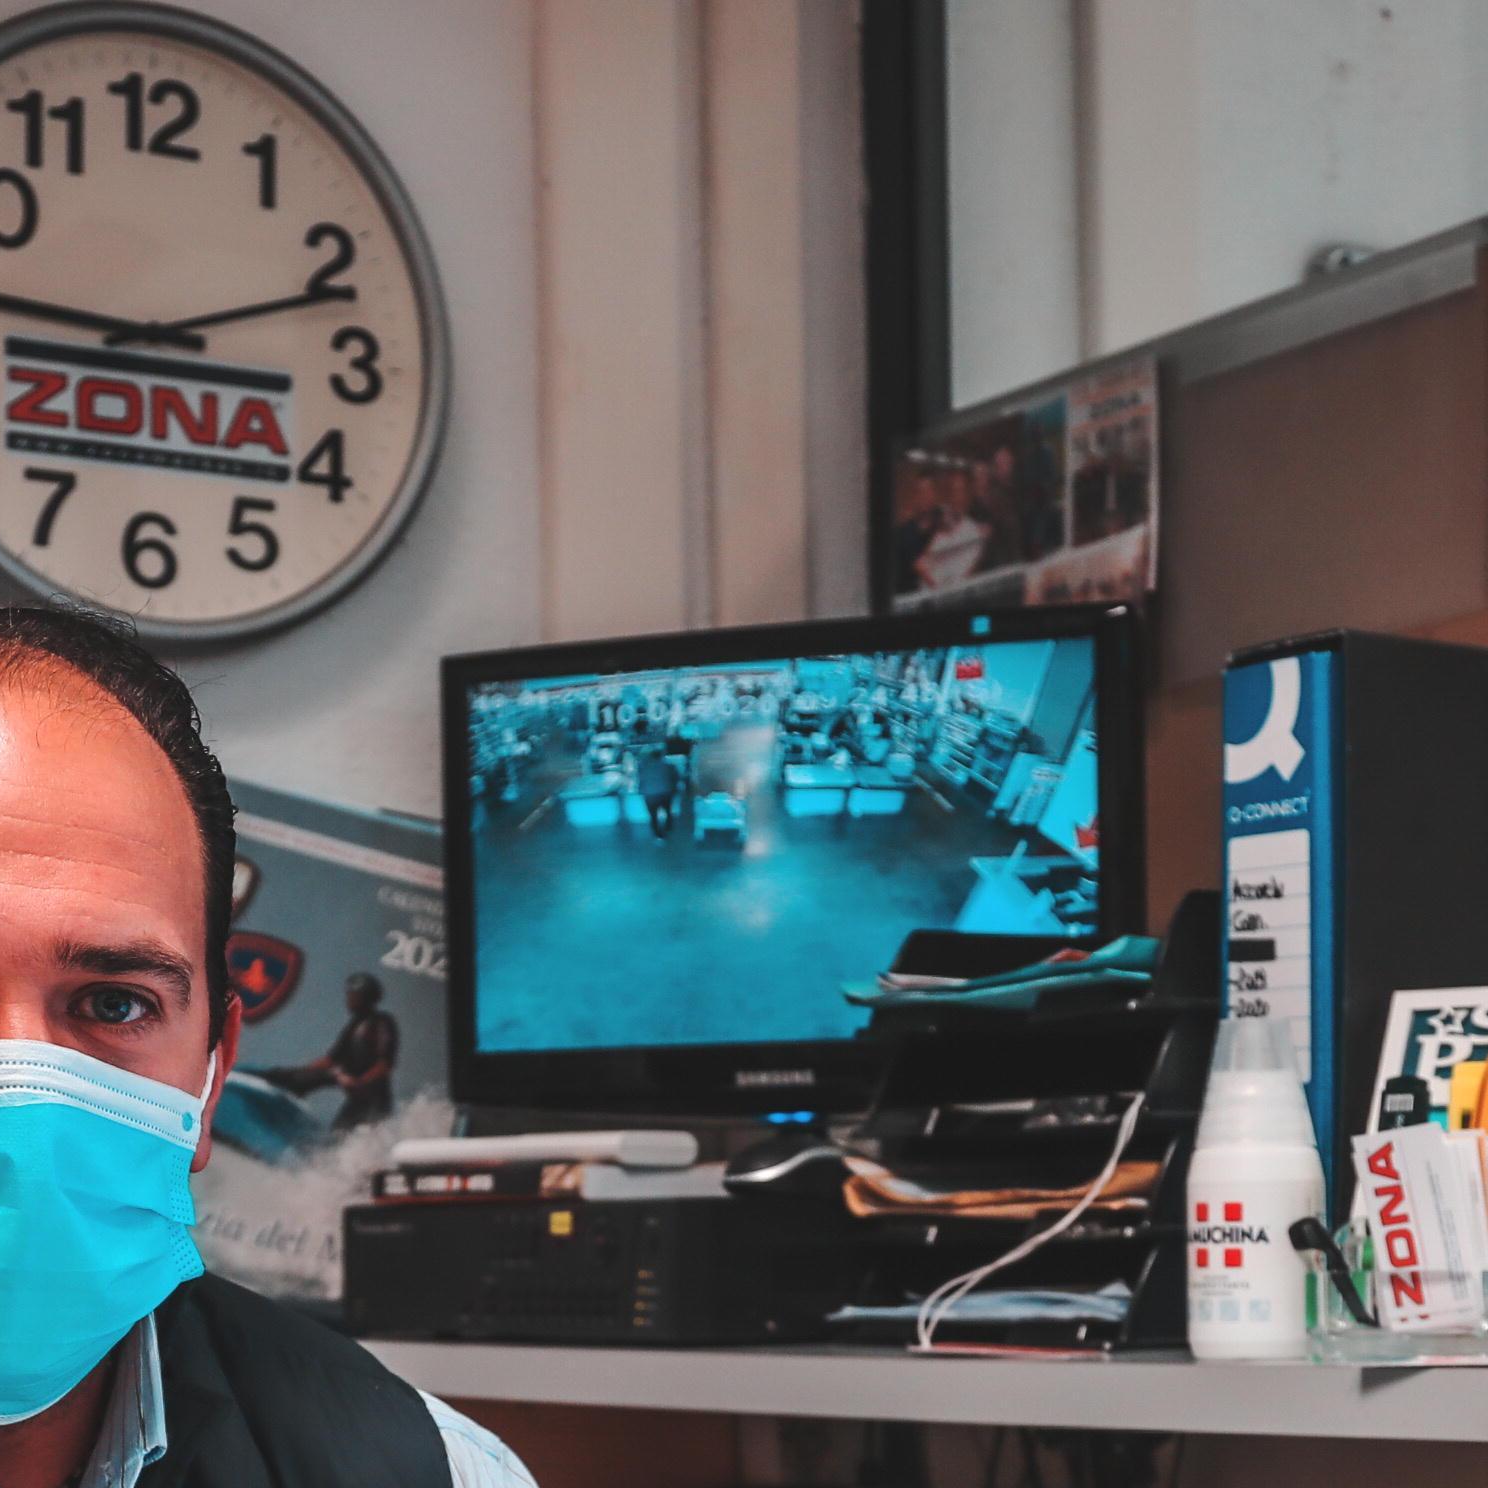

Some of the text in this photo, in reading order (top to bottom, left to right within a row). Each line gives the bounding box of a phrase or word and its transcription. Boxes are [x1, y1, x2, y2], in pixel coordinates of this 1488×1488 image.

[7, 90, 85, 176] 11
[107, 72, 202, 163] 12
[243, 134, 277, 210] 1
[304, 222, 357, 302] 2
[329, 326, 382, 406] 3
[7, 365, 290, 456] ZONA
[297, 429, 353, 503] 4
[22, 467, 77, 547] 7
[224, 496, 280, 573] 5
[122, 511, 177, 591] 6
[1367, 1141, 1425, 1308] ZONA
